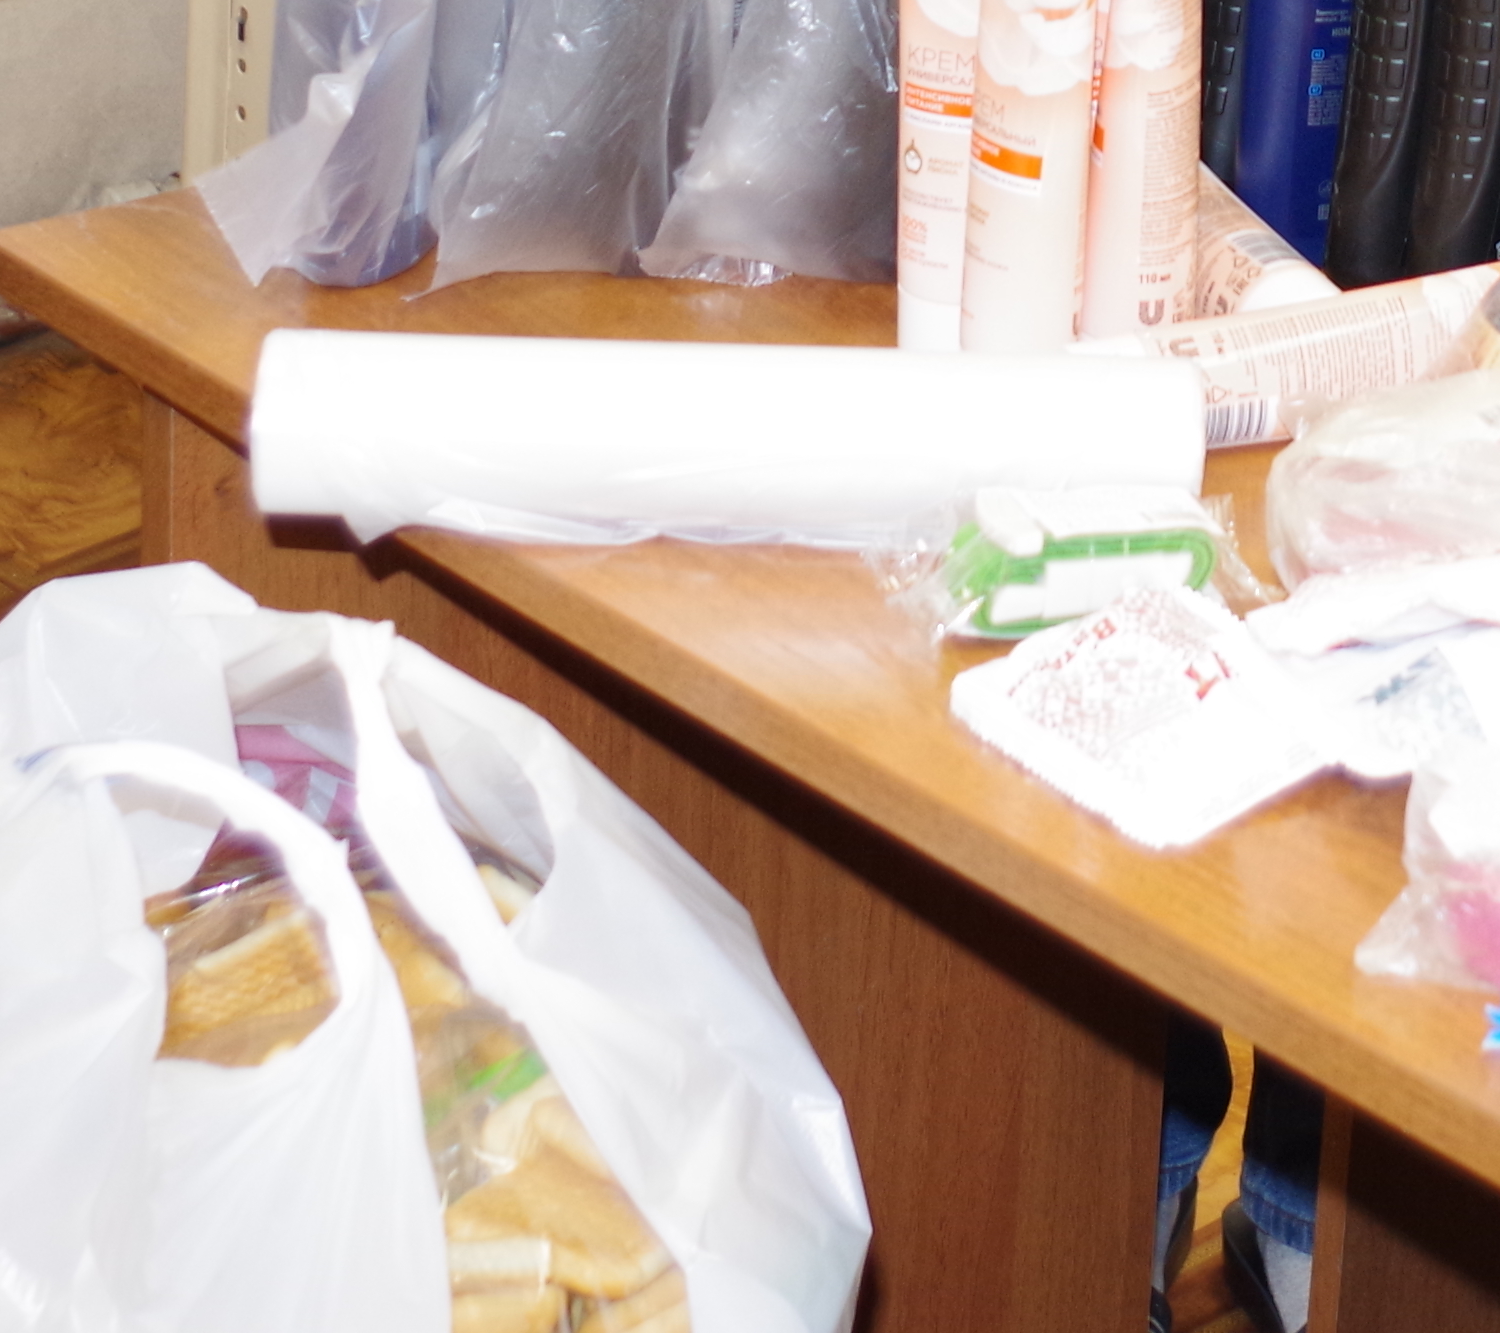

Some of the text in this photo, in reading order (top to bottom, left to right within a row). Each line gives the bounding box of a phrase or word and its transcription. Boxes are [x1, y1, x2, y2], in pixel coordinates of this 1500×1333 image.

[904, 85, 973, 107] ИНТЕНСИВНОЕ
[904, 98, 947, 113] ПИТАНИЕ
[1138, 272, 1159, 286] 110
